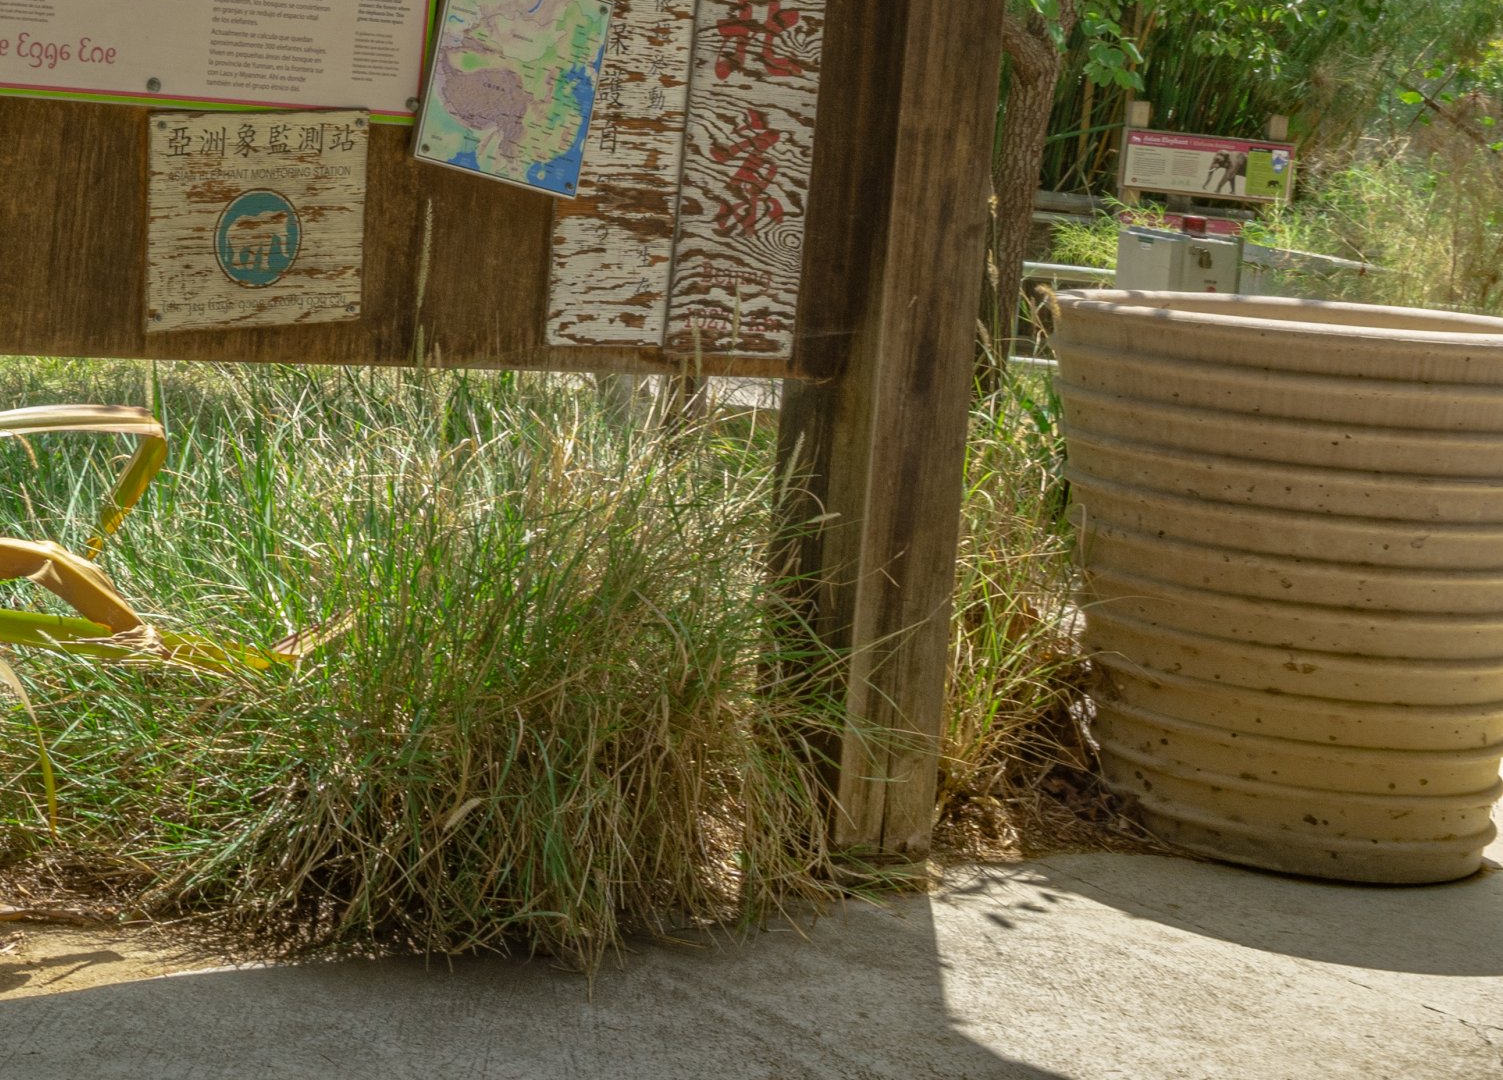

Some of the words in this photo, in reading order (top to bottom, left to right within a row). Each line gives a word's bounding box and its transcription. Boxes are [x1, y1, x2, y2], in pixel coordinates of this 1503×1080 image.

[166, 122, 356, 158] 亞洲象監測站
[313, 166, 351, 178] STATION
